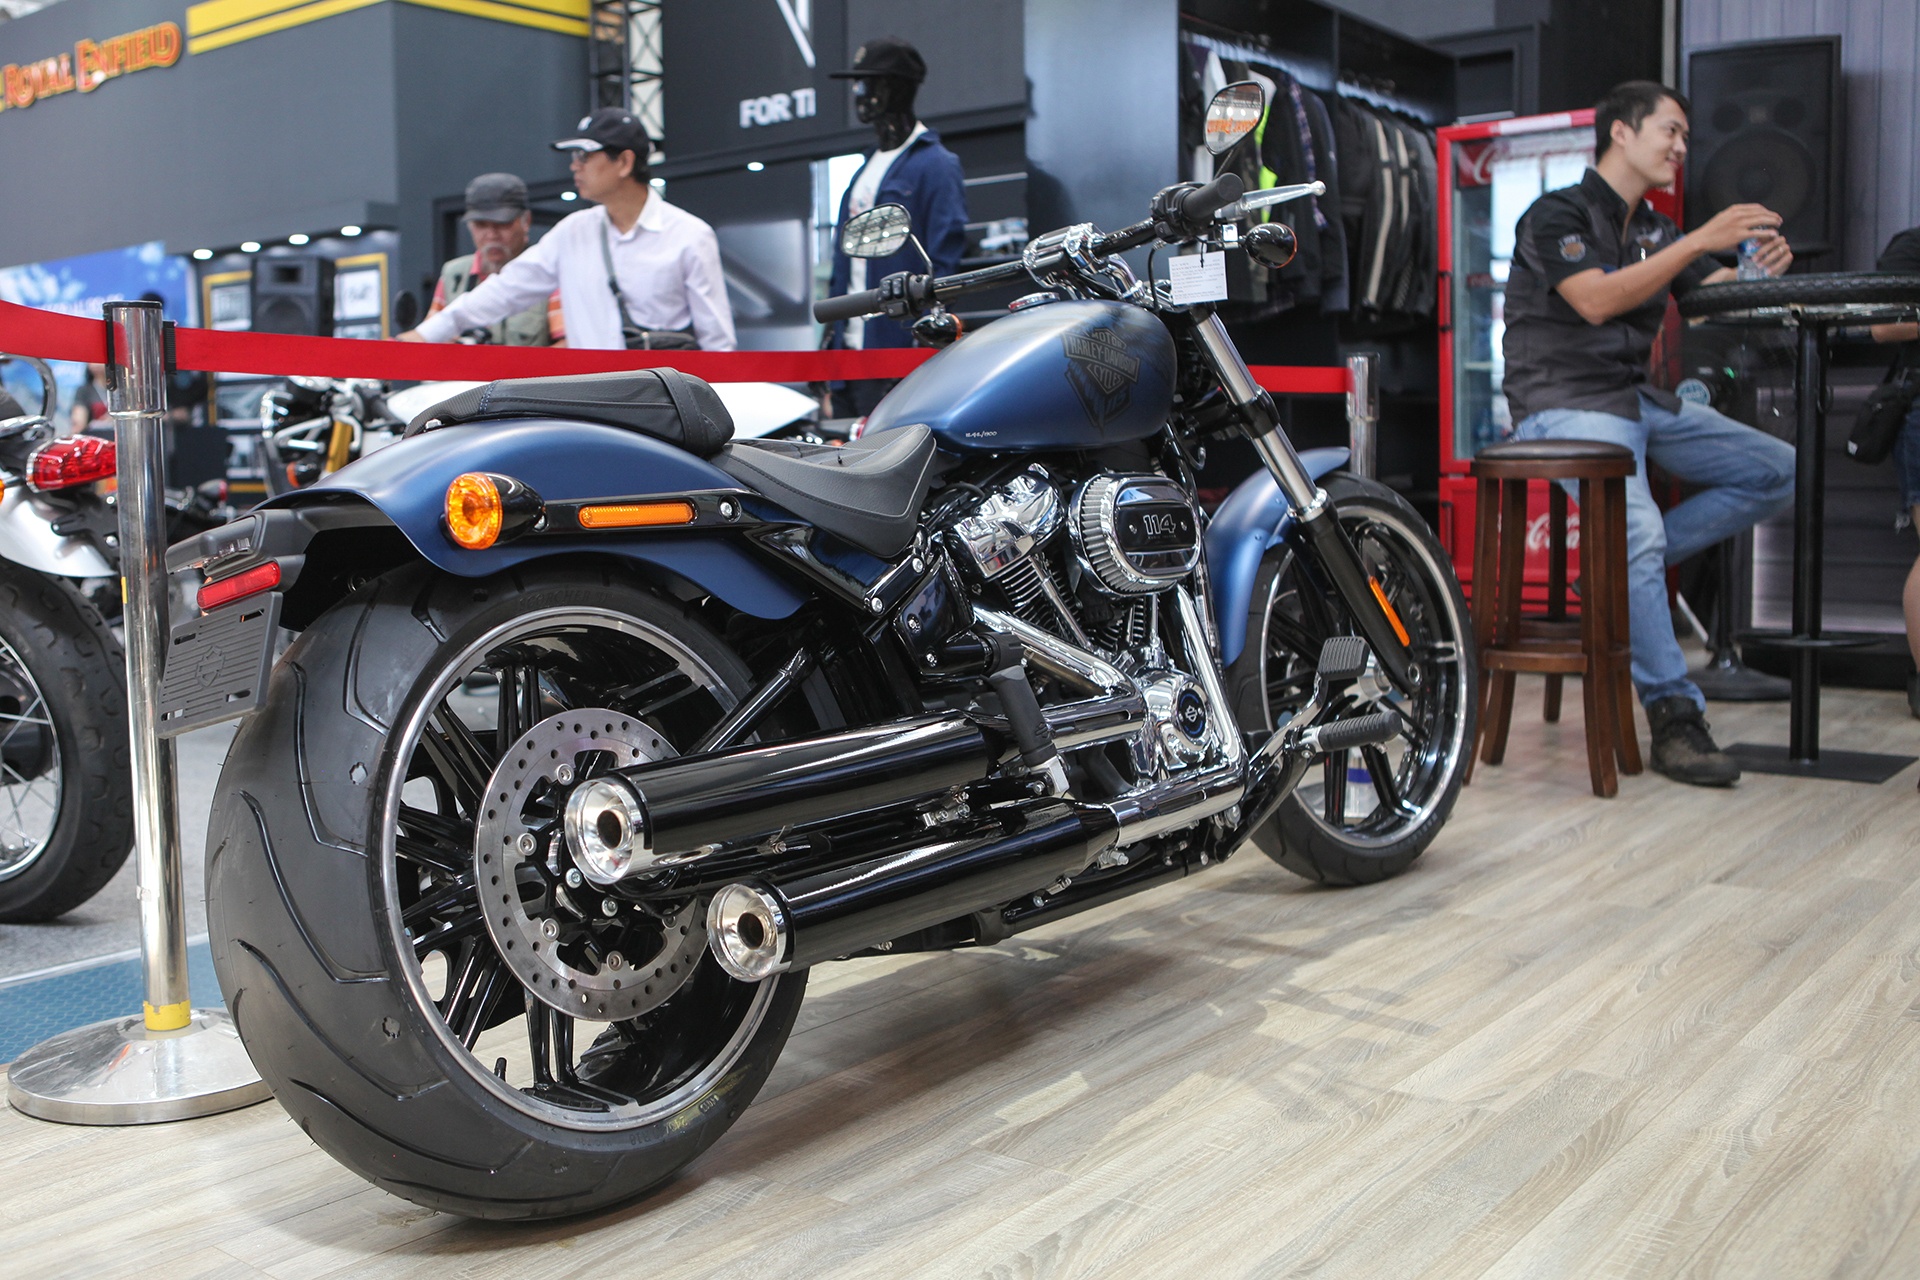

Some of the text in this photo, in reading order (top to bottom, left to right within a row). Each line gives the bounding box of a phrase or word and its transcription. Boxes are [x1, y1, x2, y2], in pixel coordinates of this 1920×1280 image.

[75, 21, 183, 93] ENFIELD
[739, 93, 793, 128] FOR
[1091, 331, 1123, 349] MOTOR
[1069, 336, 1137, 375] HARLEY-DAVIDSON
[1093, 364, 1122, 390] CYCLES
[1142, 513, 1177, 535] 114
